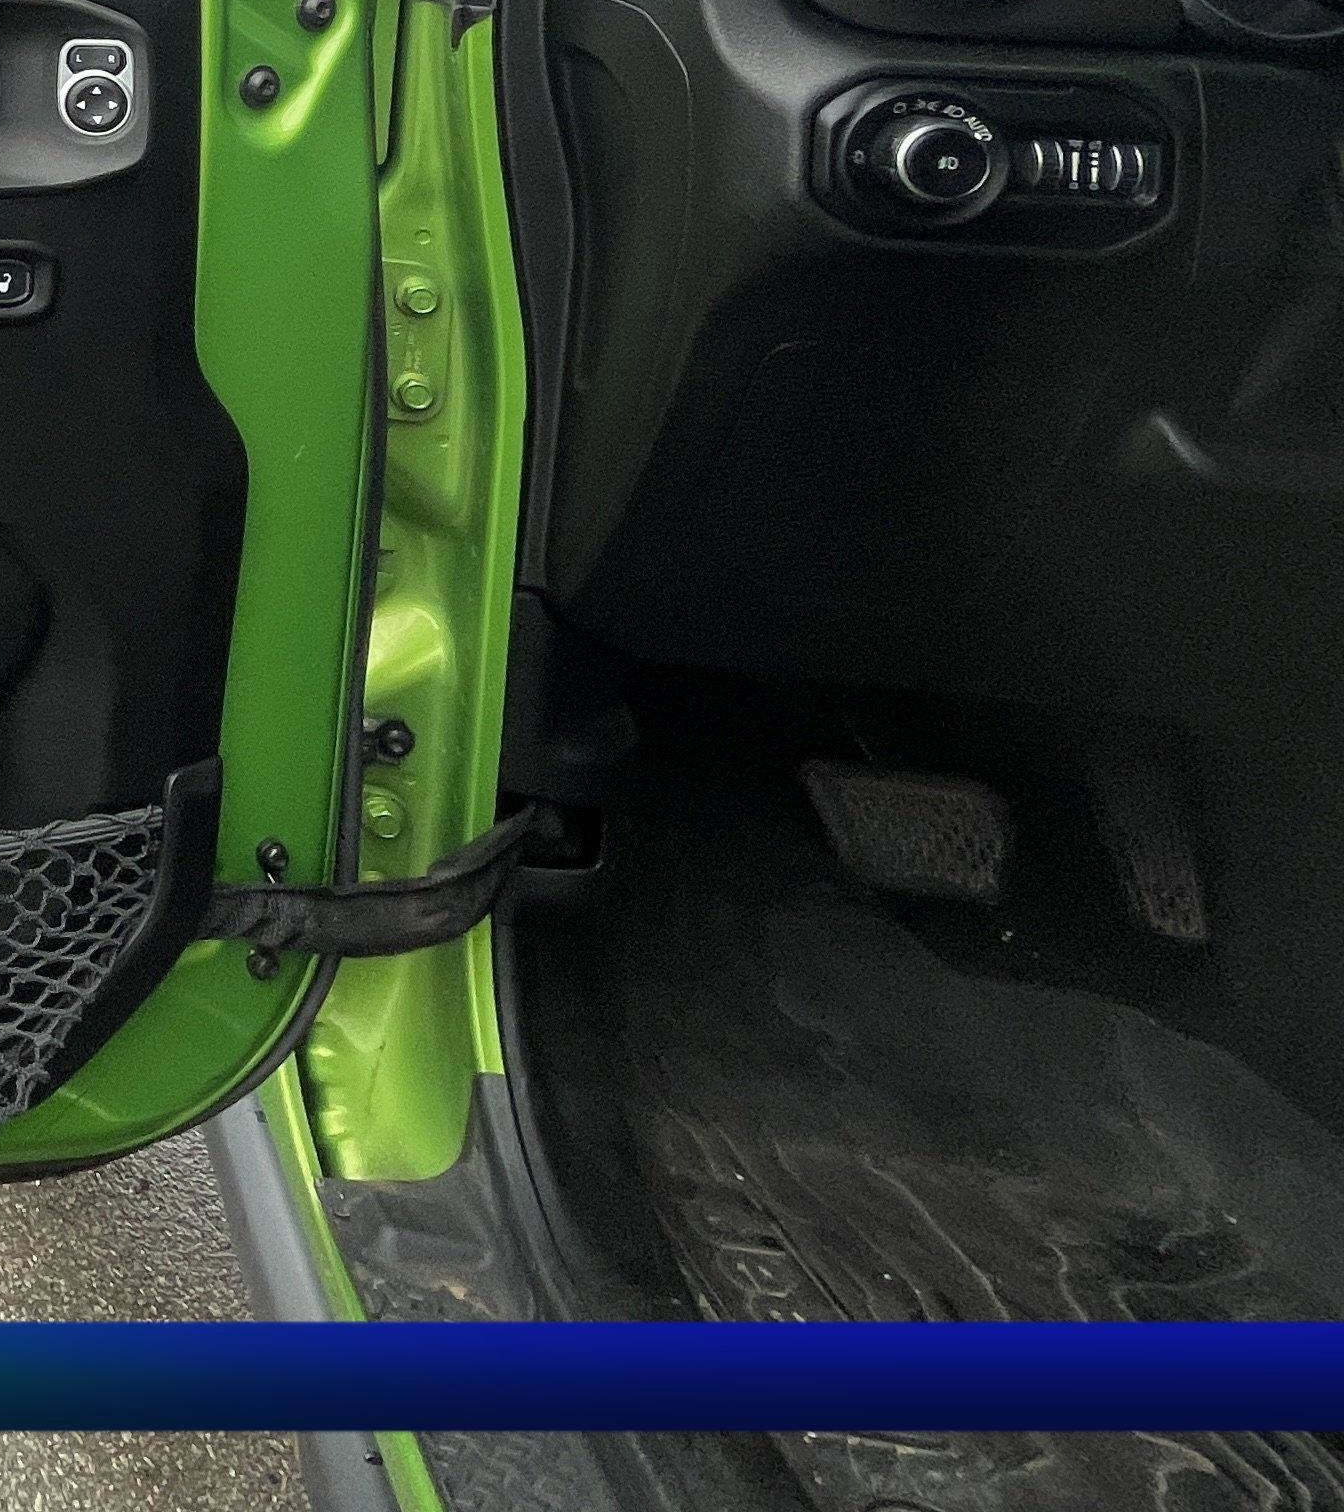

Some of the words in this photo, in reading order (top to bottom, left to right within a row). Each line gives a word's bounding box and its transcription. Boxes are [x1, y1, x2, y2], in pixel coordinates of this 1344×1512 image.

[75, 54, 82, 63] L
[108, 54, 115, 64] R
[962, 116, 993, 141] AUTO
